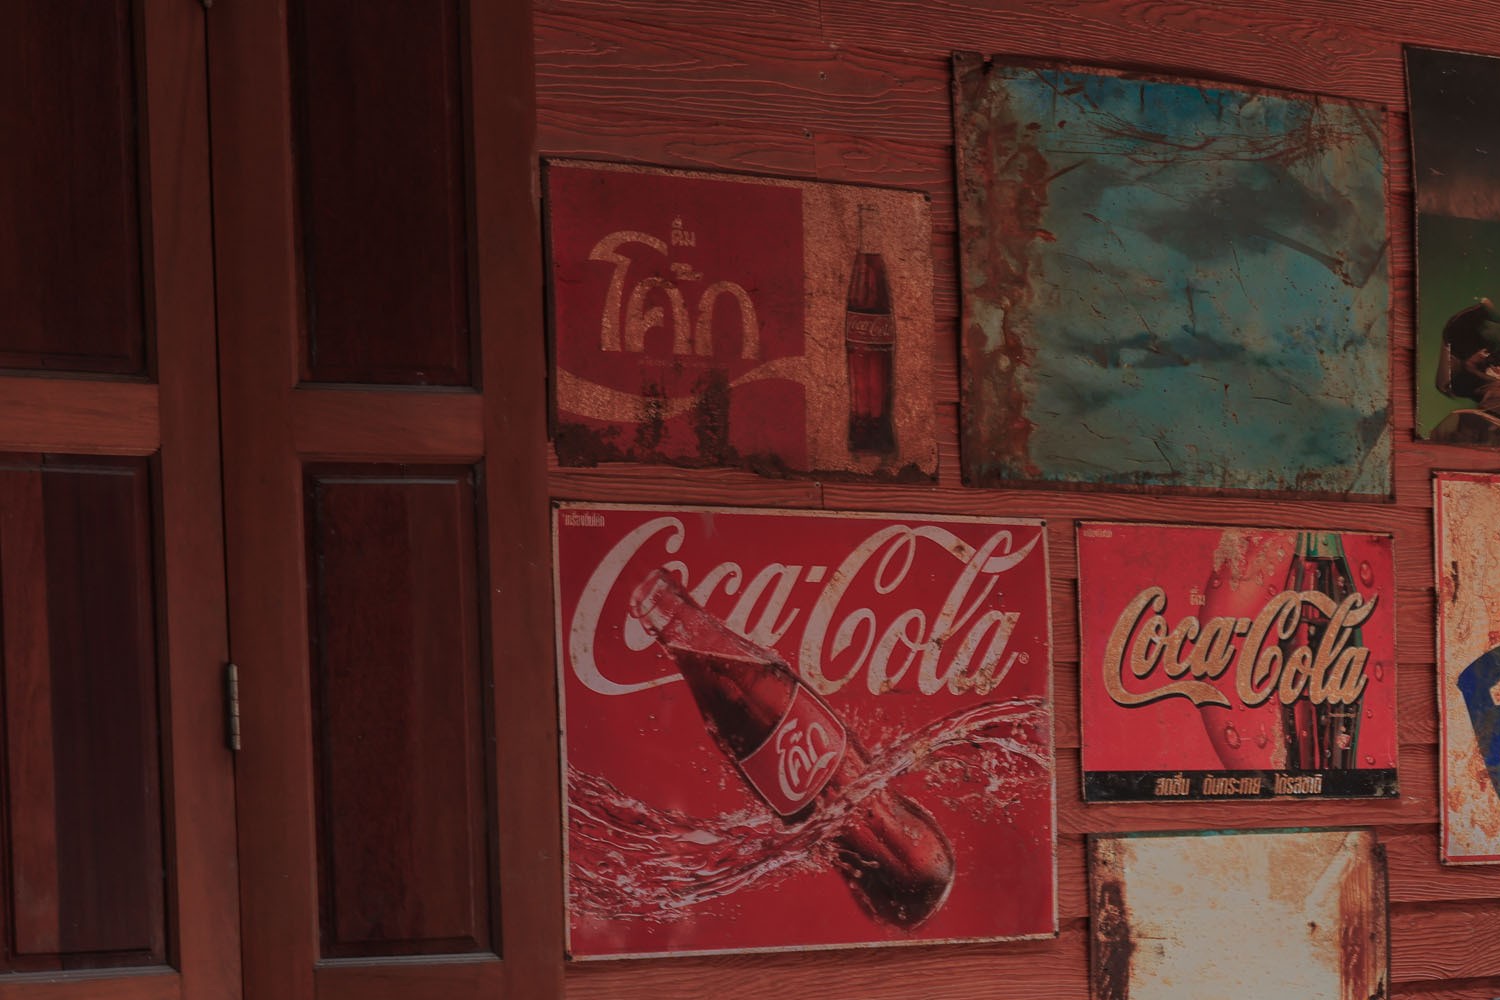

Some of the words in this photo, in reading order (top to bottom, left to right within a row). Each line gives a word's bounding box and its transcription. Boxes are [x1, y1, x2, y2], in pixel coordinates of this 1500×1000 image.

[671, 215, 696, 247] ดื่ม
[570, 516, 1042, 696] Coca-Cola
[1103, 586, 1379, 709] Coca-Cola
